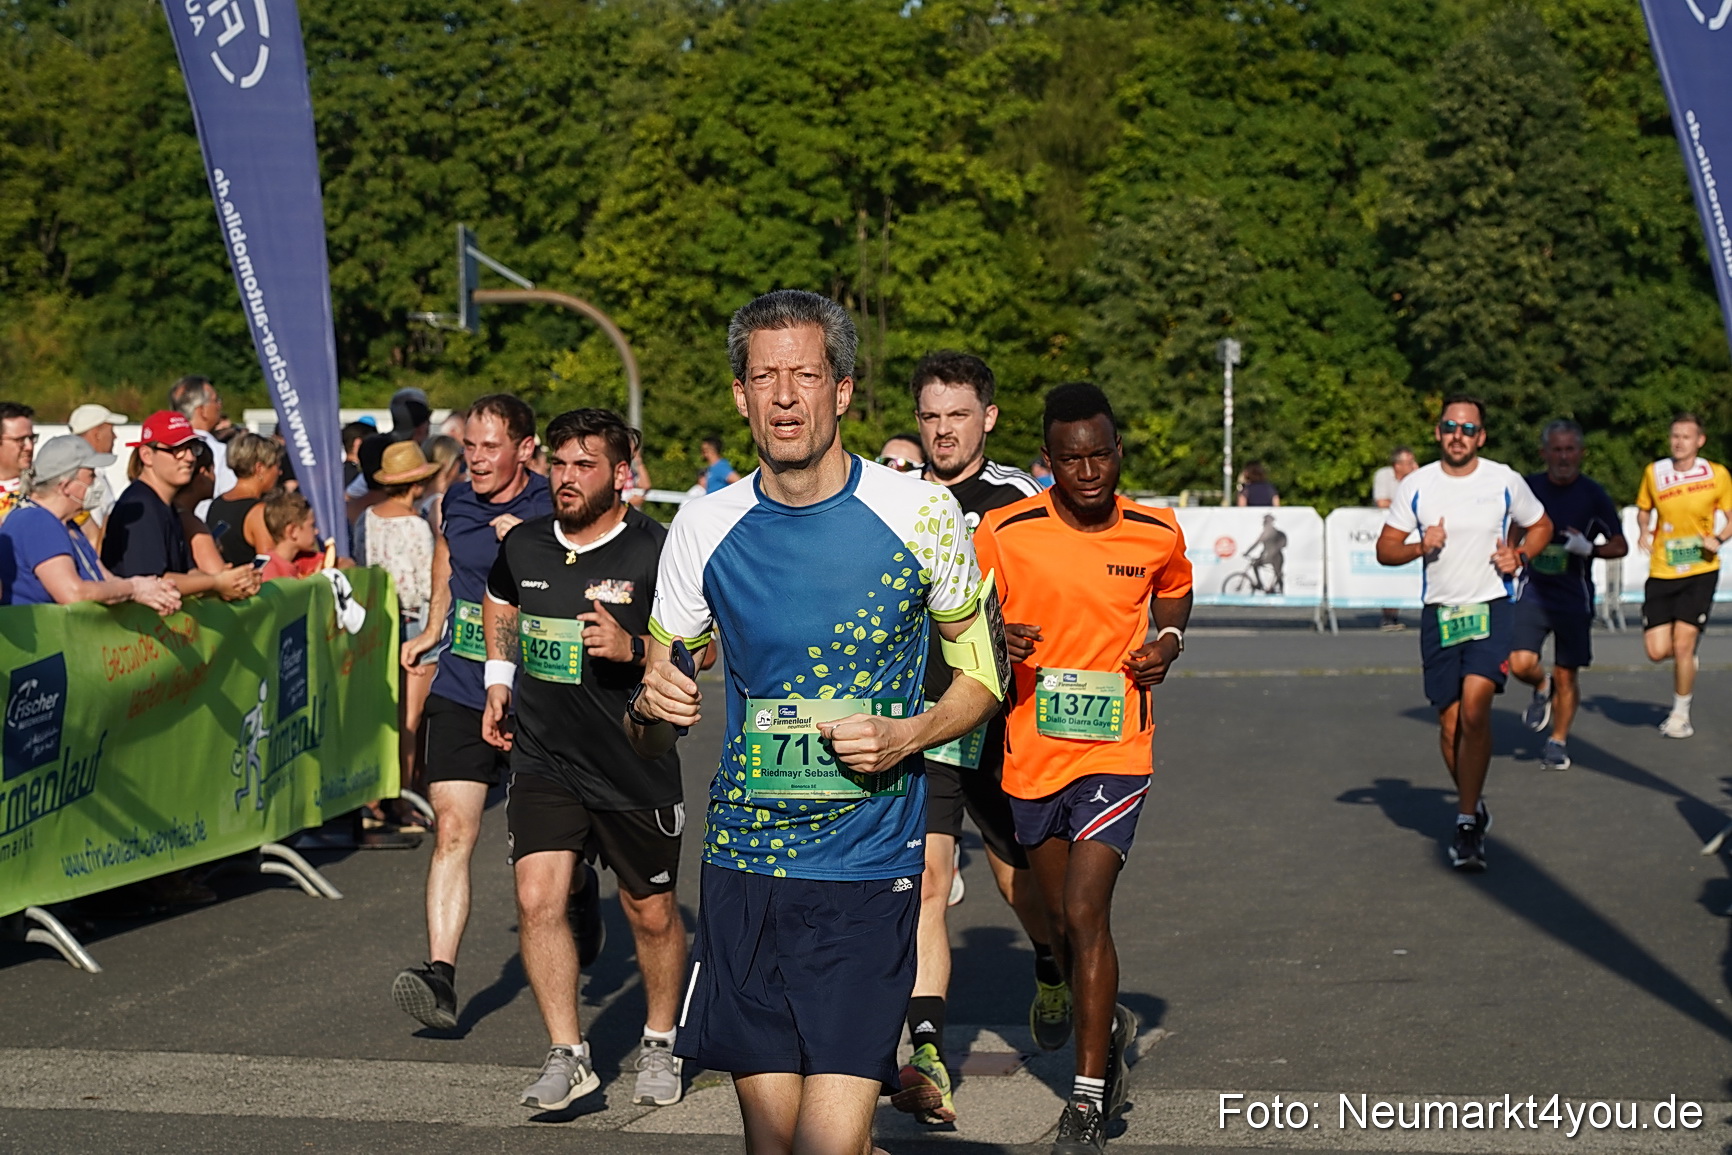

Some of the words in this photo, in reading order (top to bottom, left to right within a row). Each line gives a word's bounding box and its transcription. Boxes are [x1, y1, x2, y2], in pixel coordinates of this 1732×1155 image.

[1106, 564, 1146, 578] THULE
[1452, 615, 1474, 631] 311
[530, 637, 562, 661] 426
[569, 645, 579, 675] 2022
[15, 692, 60, 722] Fischer
[1039, 698, 1048, 722] RUN
[1049, 692, 1111, 718] 1377
[1110, 700, 1121, 732] 2022
[773, 716, 812, 726] Firmenlauf
[1047, 715, 1067, 725] Diallo
[1068, 717, 1092, 726] Diarra
[1092, 719, 1111, 728] Gaye
[968, 732, 981, 760] 2022
[752, 744, 762, 778] RUN
[761, 768, 802, 780] Riedmayr
